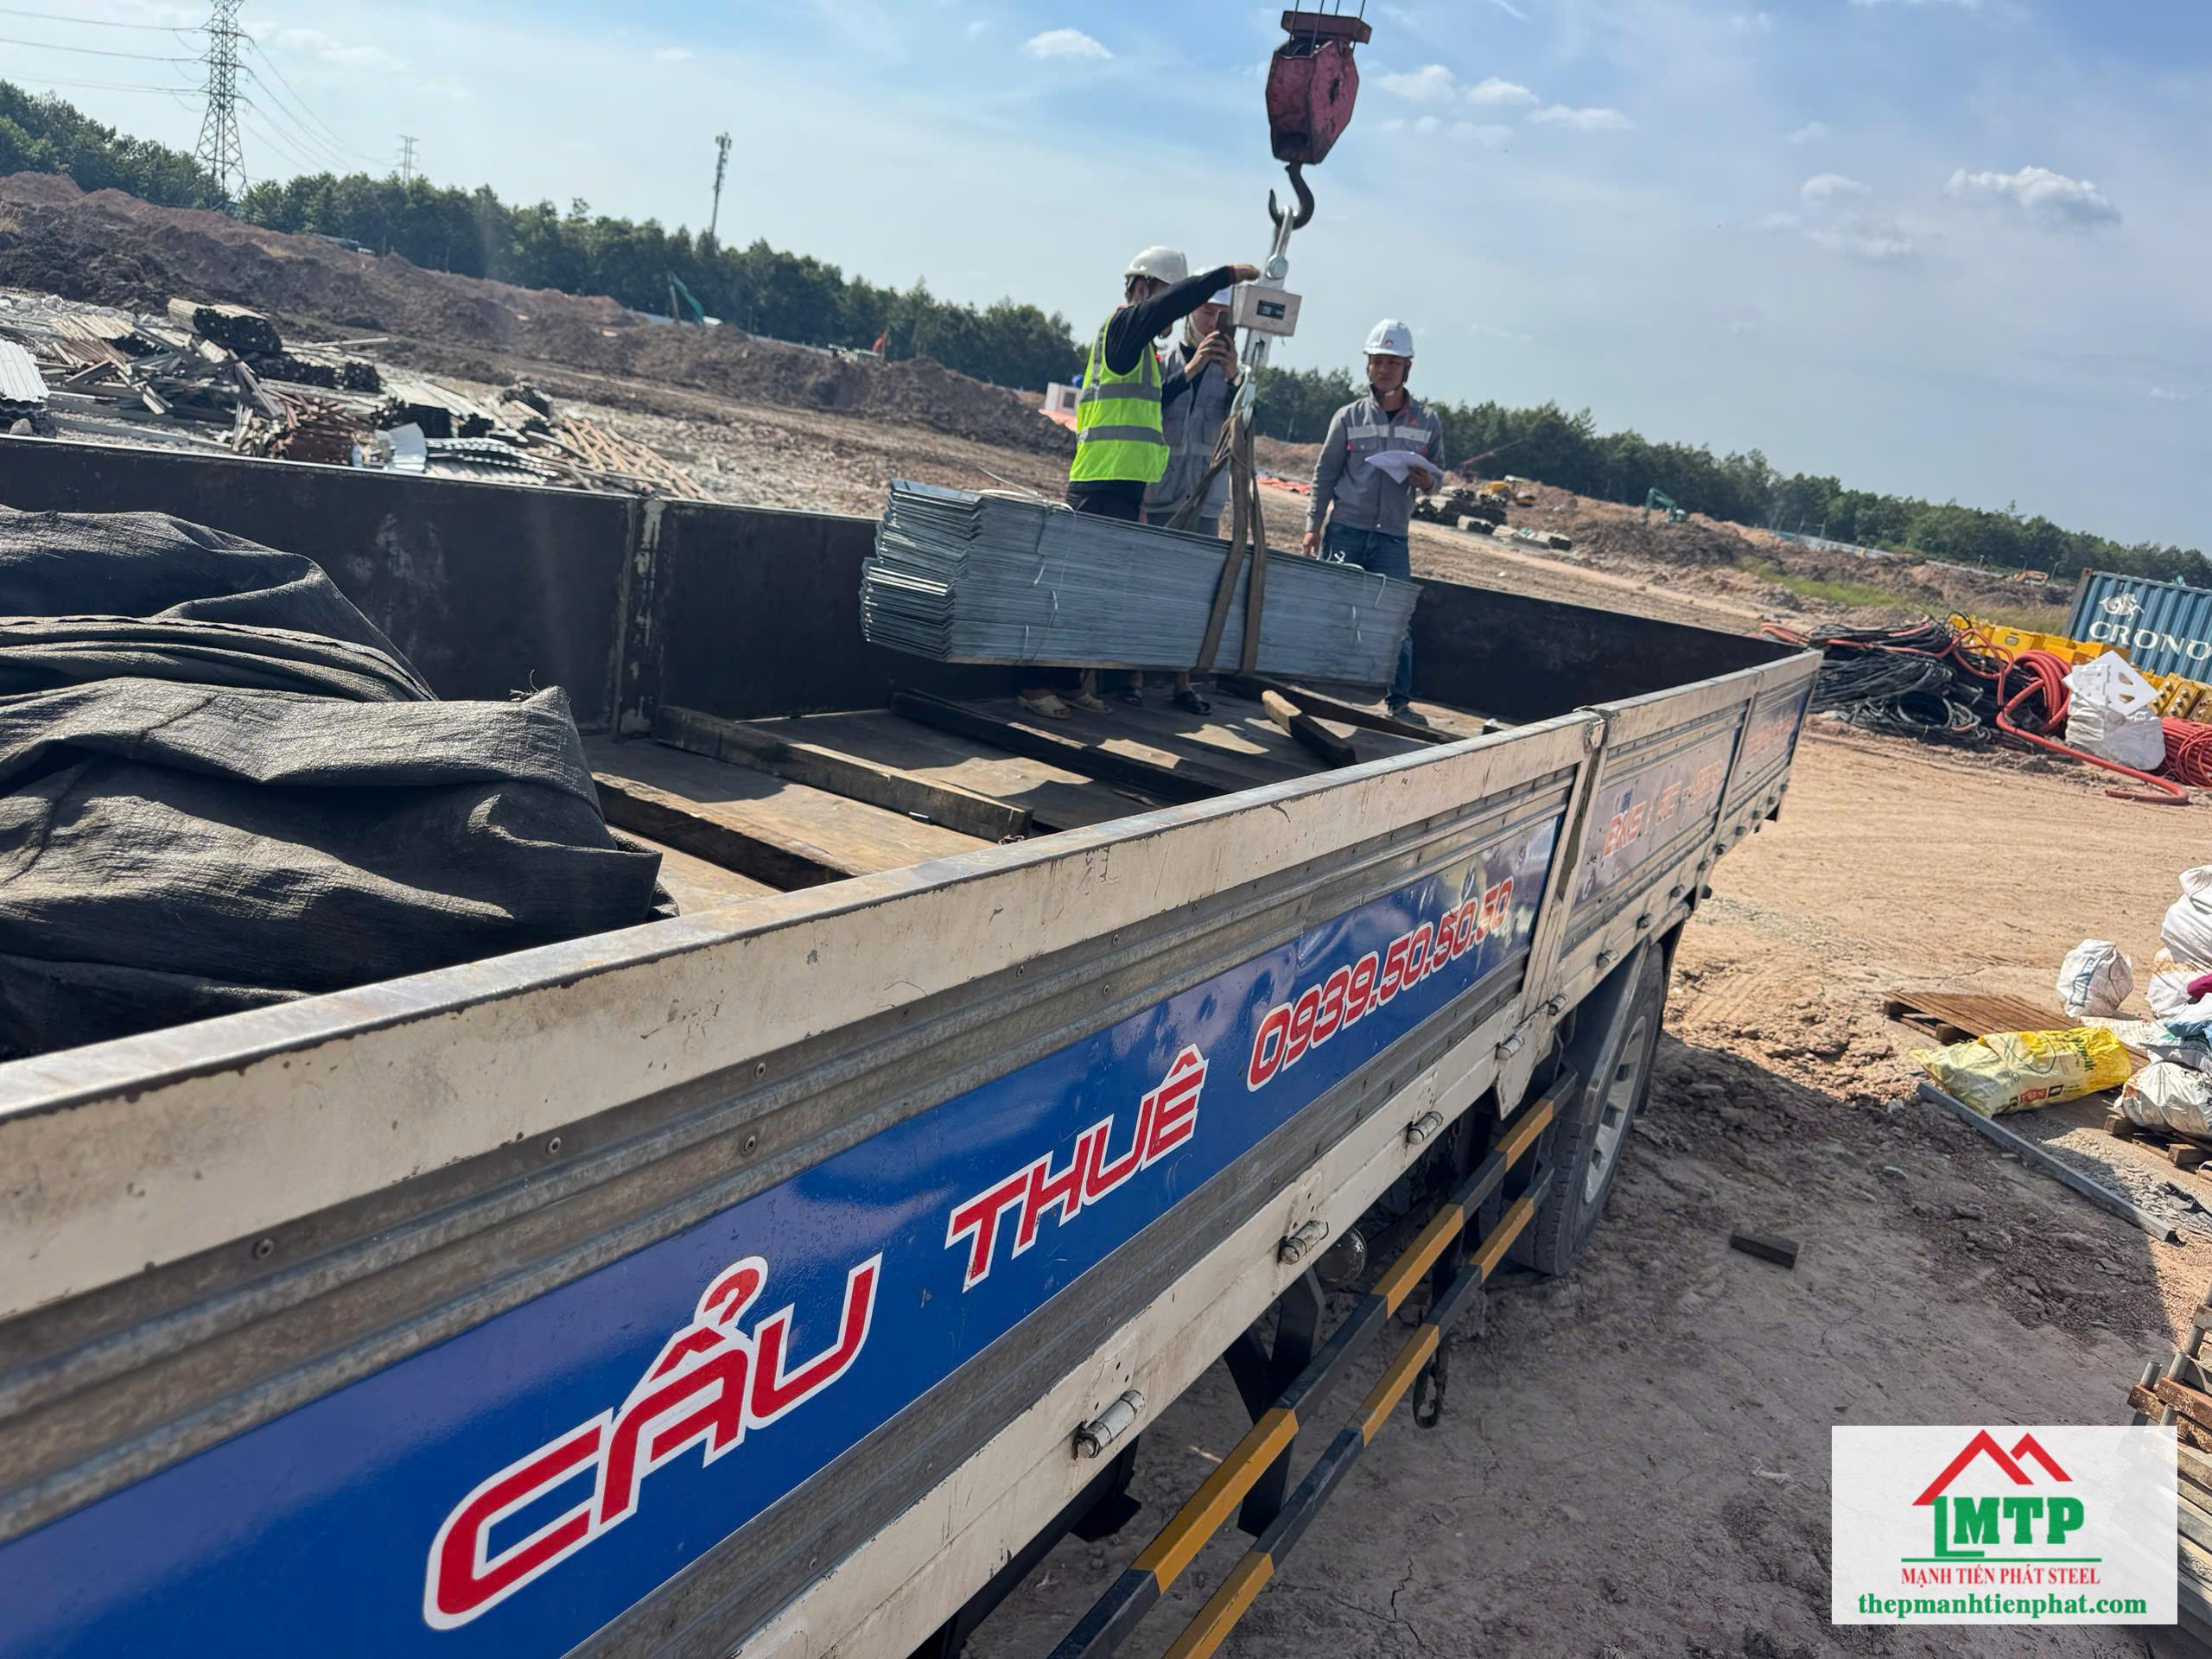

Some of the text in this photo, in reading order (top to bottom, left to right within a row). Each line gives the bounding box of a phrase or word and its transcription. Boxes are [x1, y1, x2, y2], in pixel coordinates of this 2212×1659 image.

[2089, 620, 2212, 661] CRONO
[423, 875, 1514, 1630] CẨU THUÊ 0939.50.50.50
